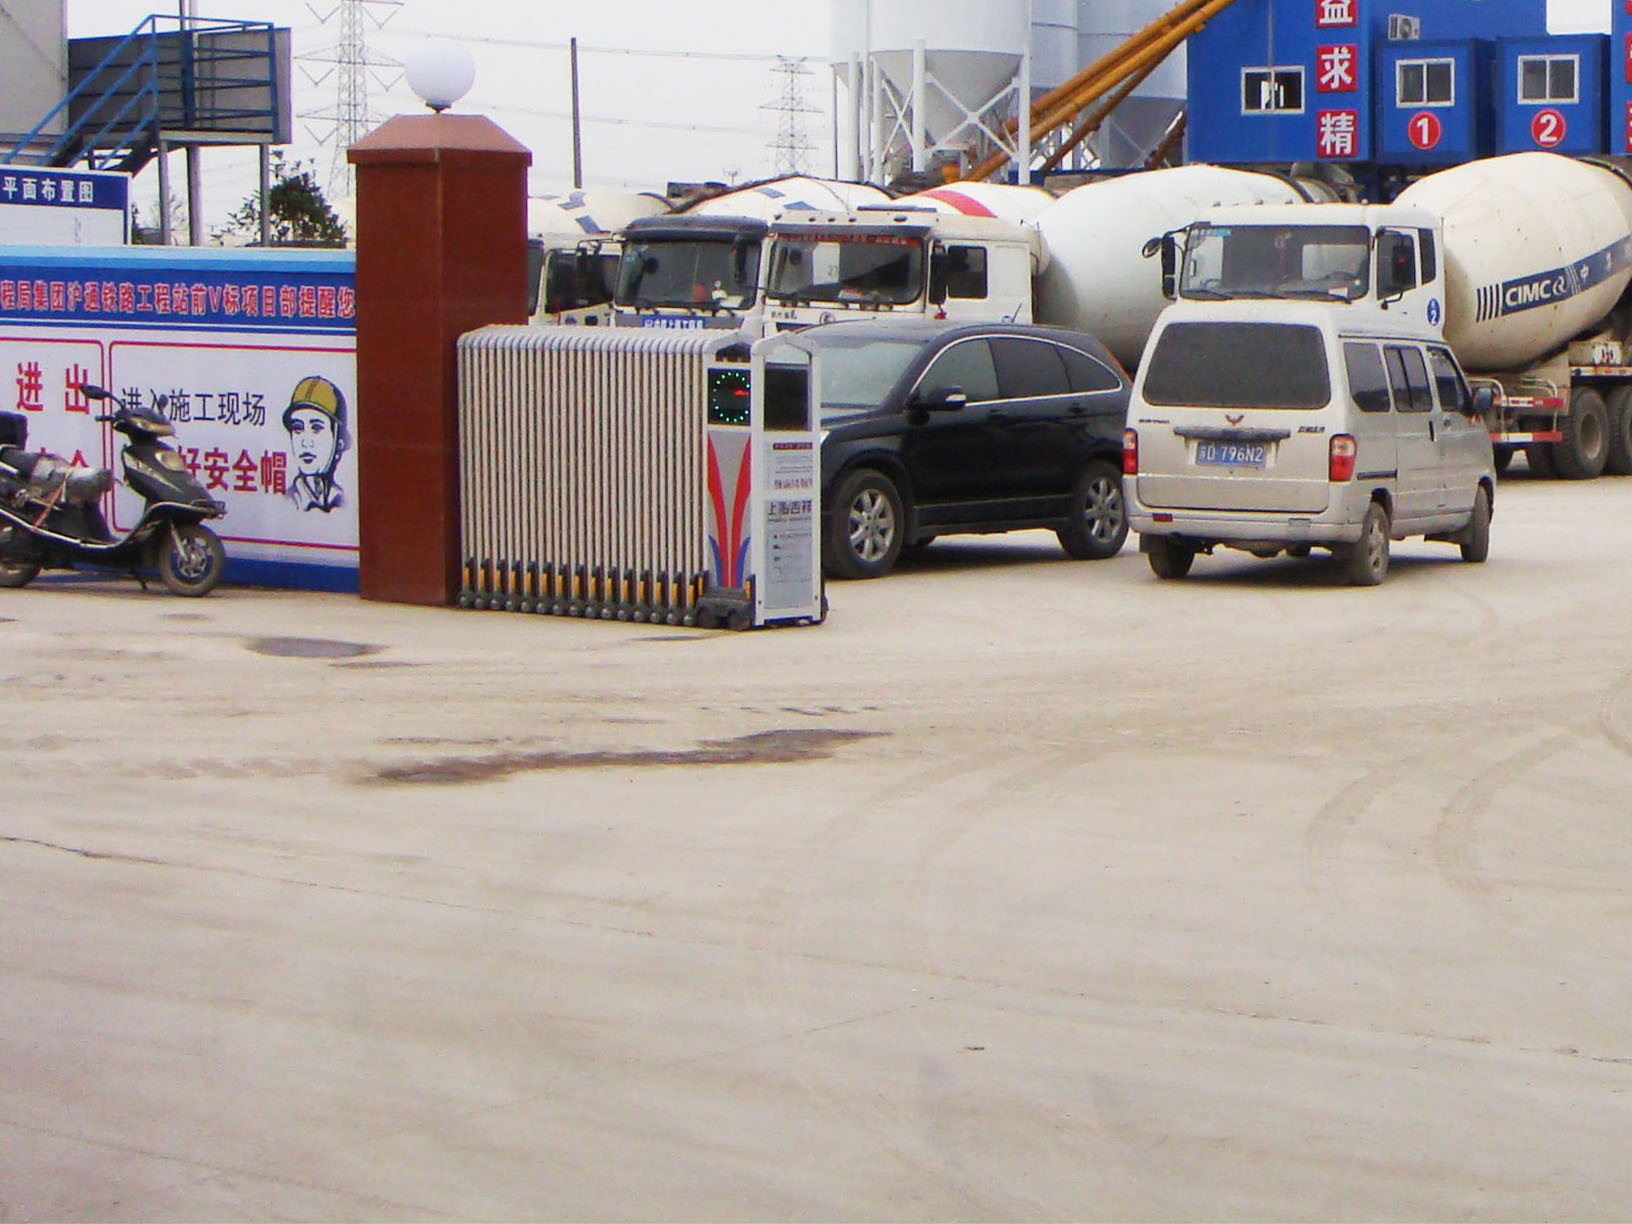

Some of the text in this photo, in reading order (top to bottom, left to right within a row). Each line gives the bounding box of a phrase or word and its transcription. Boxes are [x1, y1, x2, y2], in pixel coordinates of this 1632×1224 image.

[1416, 116, 1433, 144] 1
[1540, 113, 1558, 144] 2
[1505, 278, 1552, 307] CIMC
